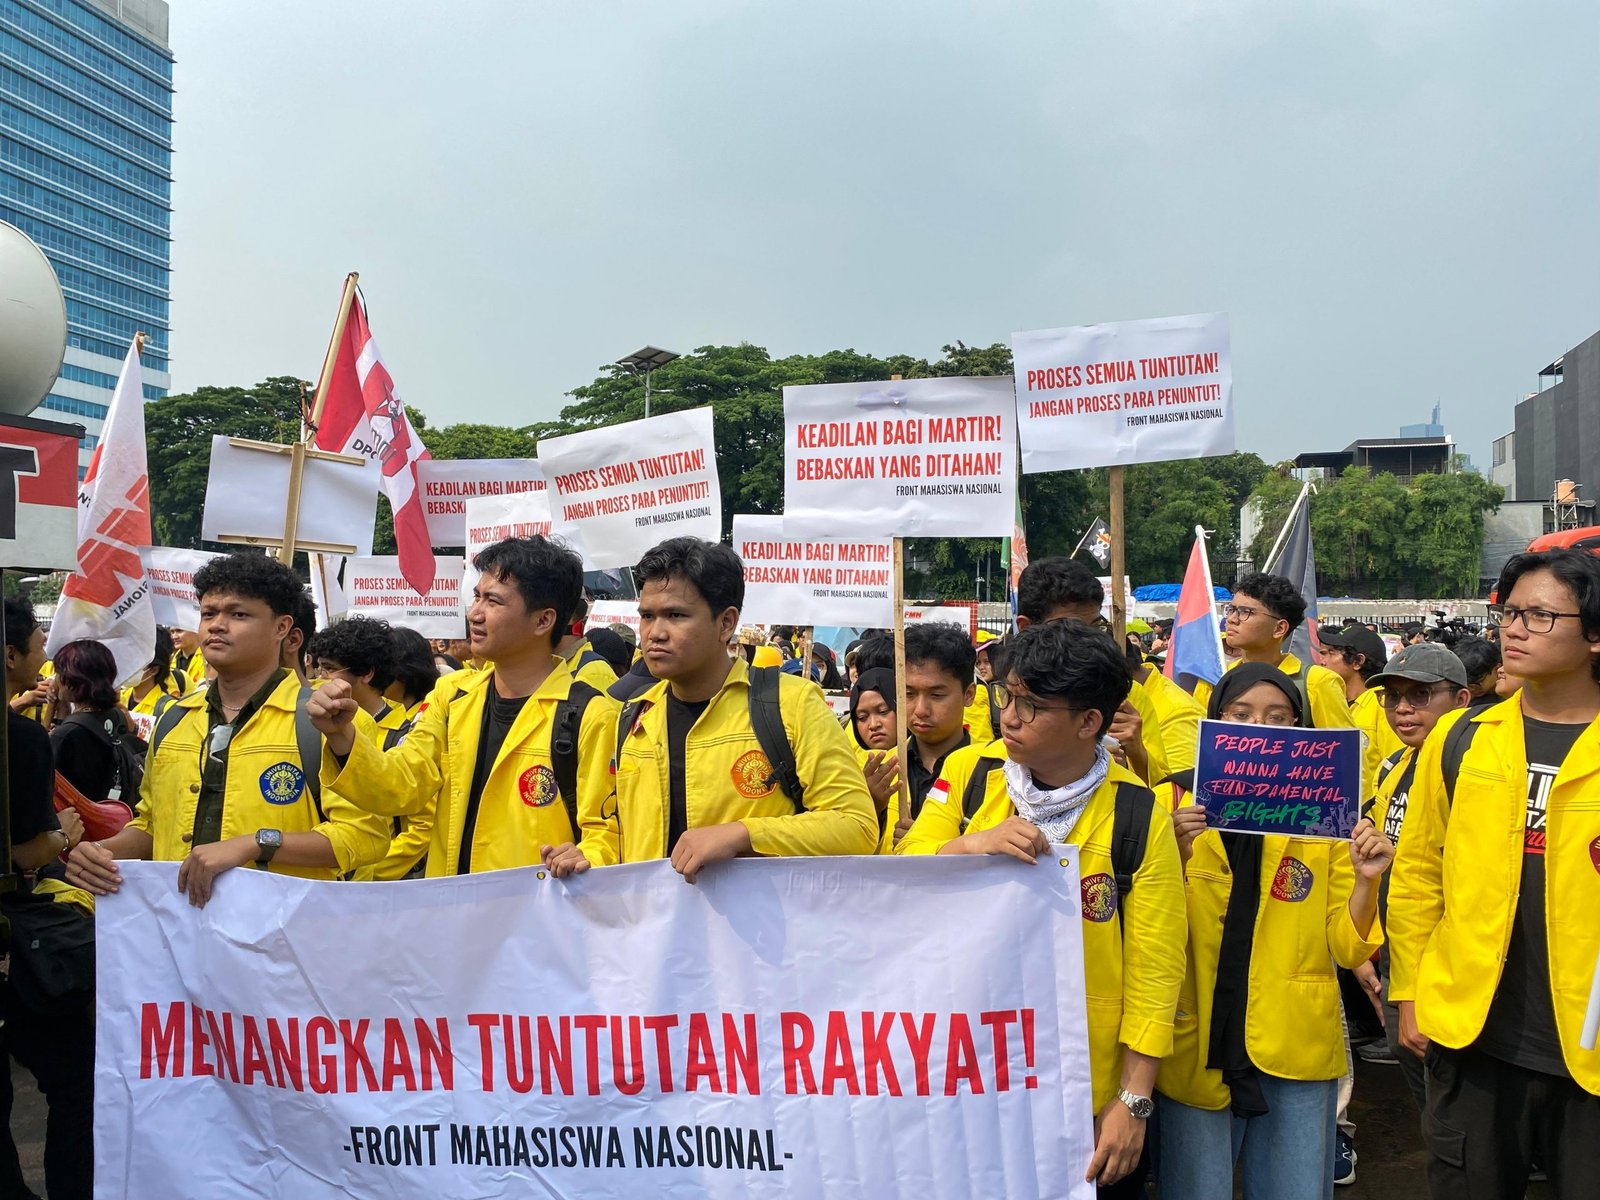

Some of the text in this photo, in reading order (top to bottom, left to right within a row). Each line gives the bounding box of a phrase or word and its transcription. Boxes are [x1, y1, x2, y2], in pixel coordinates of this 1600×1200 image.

[1027, 352, 1219, 391] PROSES SEMUA TUNTUTAN!
[1029, 384, 1221, 419] JANGAN PROSES PARA PENUNTUT!
[1127, 408, 1223, 427] FRONT MAHASISWA NASIONAL
[797, 415, 1002, 448] KEADILAN BAGI MARTIR!
[554, 448, 706, 496] PROSES SEMUA TUNTUTAN!
[797, 452, 1002, 480] BEBASKAN YANG DITAHAN!
[426, 482, 476, 496] KEADILAN
[479, 481, 503, 495] BAGI
[897, 483, 1002, 496] FRONT MAHASISWA NASIONAL
[428, 502, 466, 514] BEBASK
[563, 481, 710, 521] JANGAN PROSES PARA PENUNTUT!
[635, 506, 712, 527] FRONT MAHASISWA NASIONAL
[470, 527, 491, 544] PROSES
[743, 542, 890, 562] KEADILAN BAGI MARTIR!
[147, 568, 171, 582] PROSES
[354, 578, 384, 590] PROSES
[743, 567, 889, 585] BEBASKAN YANG DITAHAN!
[354, 596, 459, 607] JANGAN PROSES PARA PENUNTUT!
[830, 590, 861, 598] MAHASISWA
[863, 591, 888, 599] NASIONAL
[1215, 734, 1341, 759] PEOPLE JUST
[264, 765, 302, 780] UNIVERSITAS
[523, 768, 555, 784] UNIVERSITAS
[1223, 760, 1335, 781] WANNA HAVE
[265, 788, 300, 802] INDONESIA
[523, 791, 555, 805] INDONESIA
[1221, 800, 1322, 827] RIGHTS
[1082, 876, 1117, 896] UNIVERSITAS
[139, 1000, 1038, 1097] MENANGKAN TUNTUTAN RAKYAT!
[343, 1123, 793, 1172] -FRONT MAHASISWA NASIONAL-
